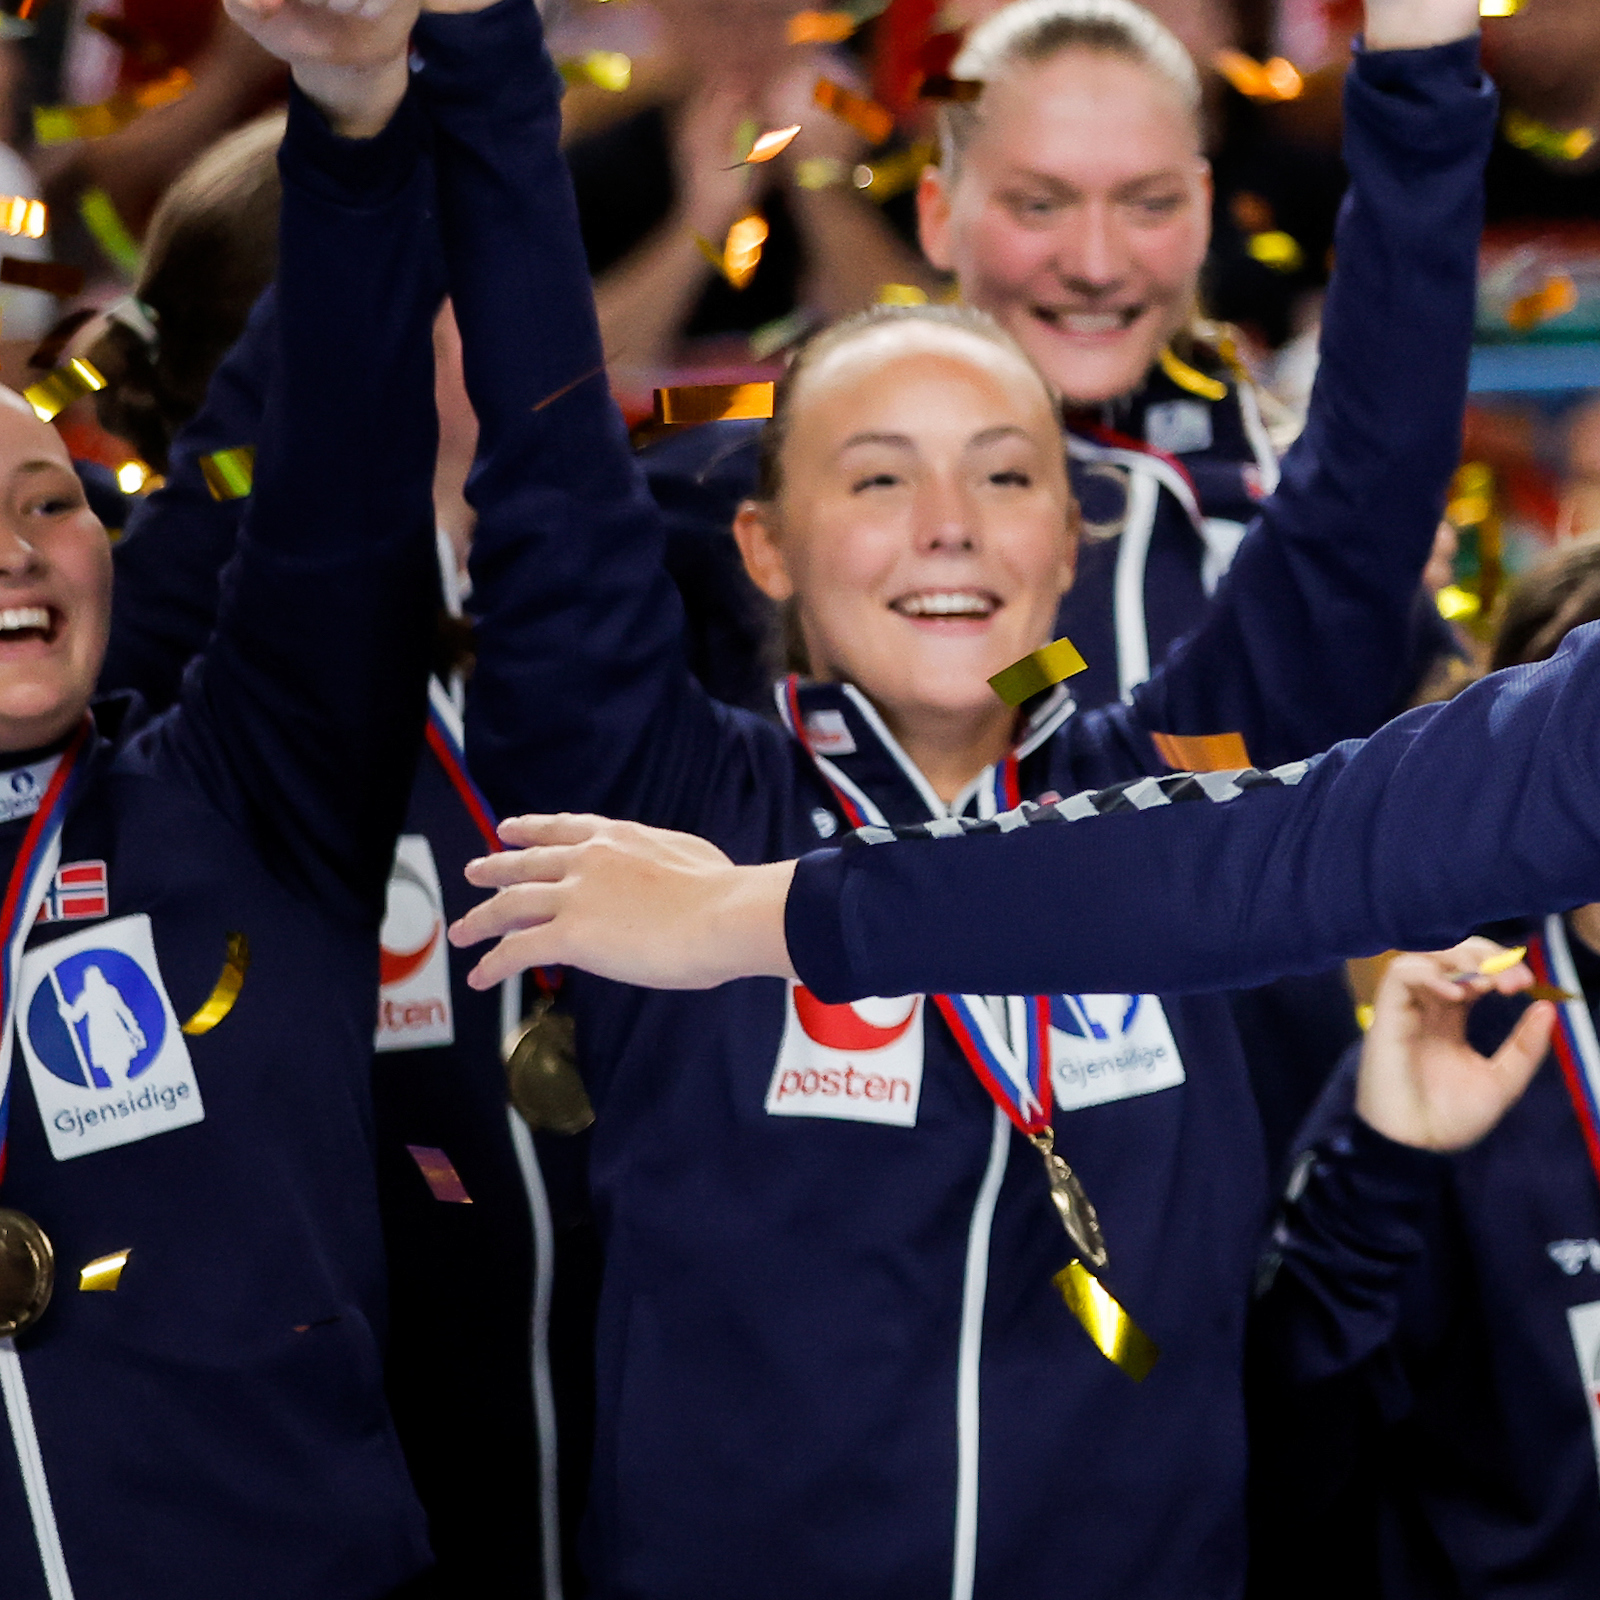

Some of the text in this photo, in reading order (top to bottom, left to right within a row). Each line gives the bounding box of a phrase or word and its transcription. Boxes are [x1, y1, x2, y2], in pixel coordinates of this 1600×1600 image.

[777, 1061, 912, 1106] posten
[1056, 1044, 1169, 1090] Gjensidige
[54, 1080, 190, 1138] Gjensidige
